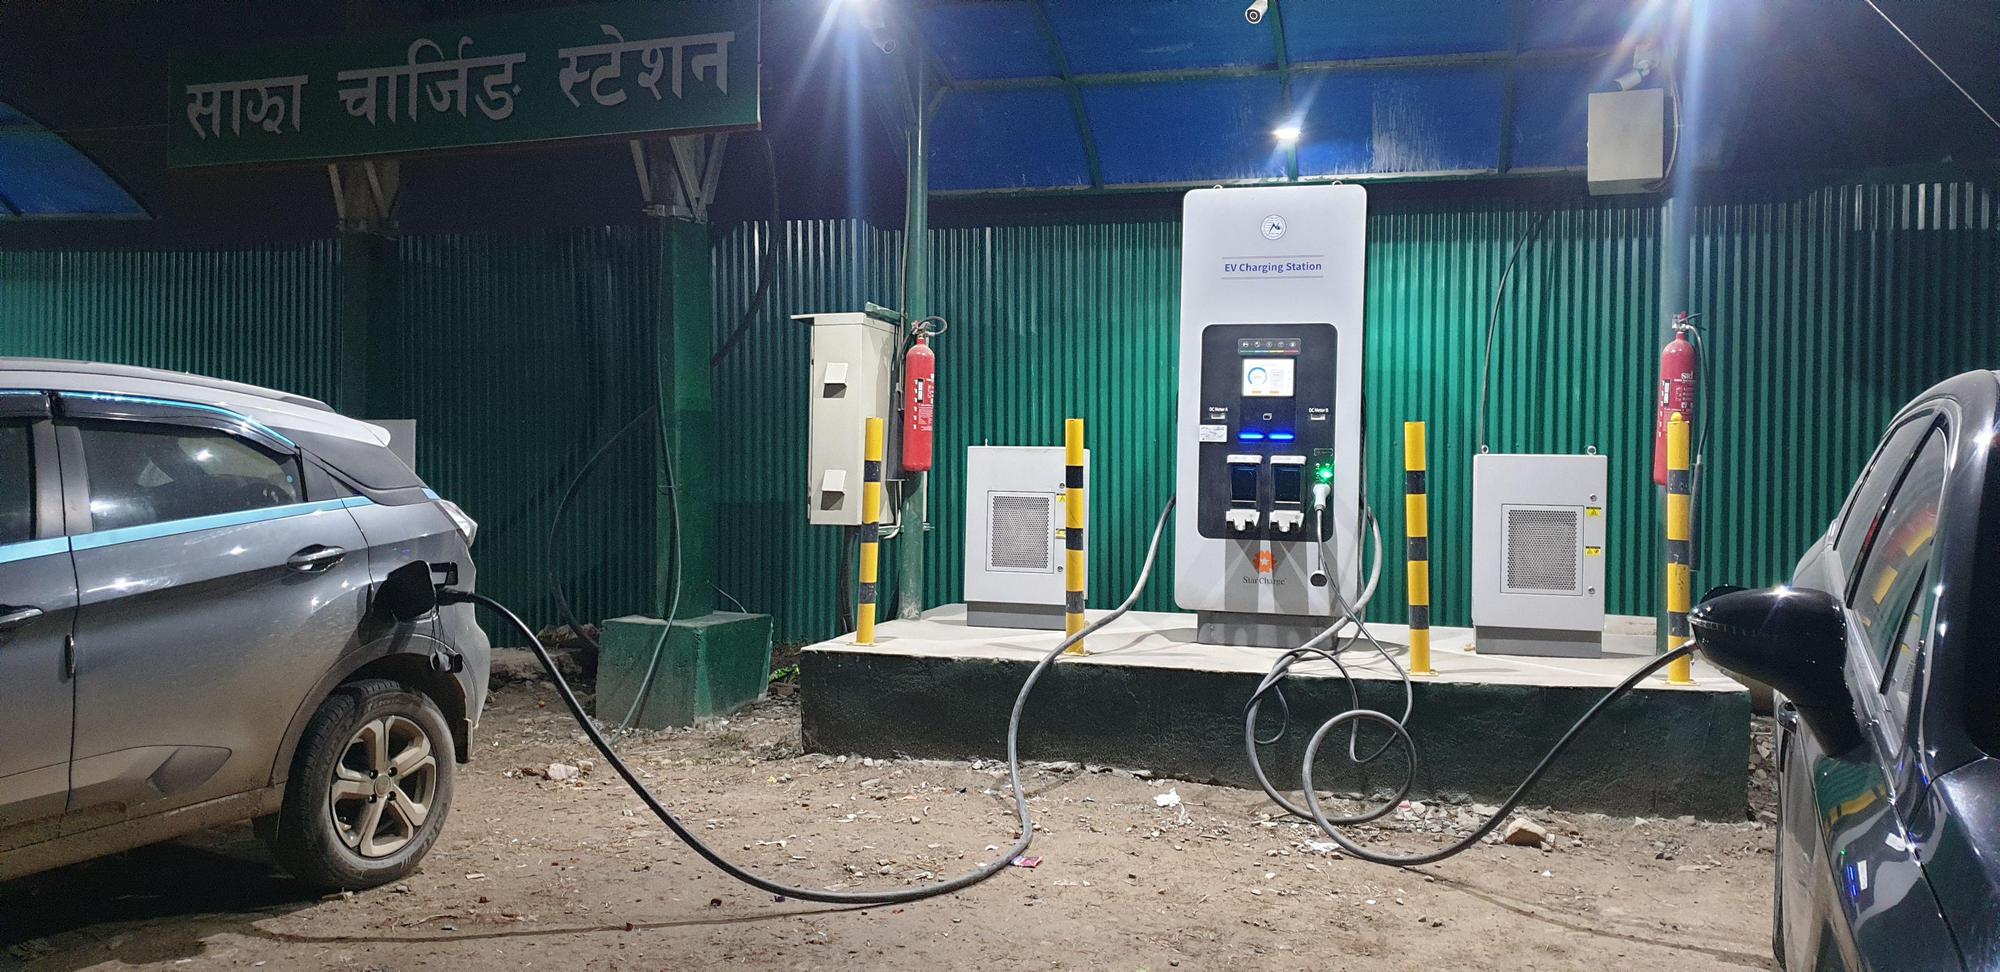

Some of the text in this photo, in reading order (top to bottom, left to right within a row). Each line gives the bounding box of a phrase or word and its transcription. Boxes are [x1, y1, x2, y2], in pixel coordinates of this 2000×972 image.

[186, 24, 735, 140] साझा चार्जिङ स्टेशन
[1224, 261, 1323, 274] EV Charging Station
